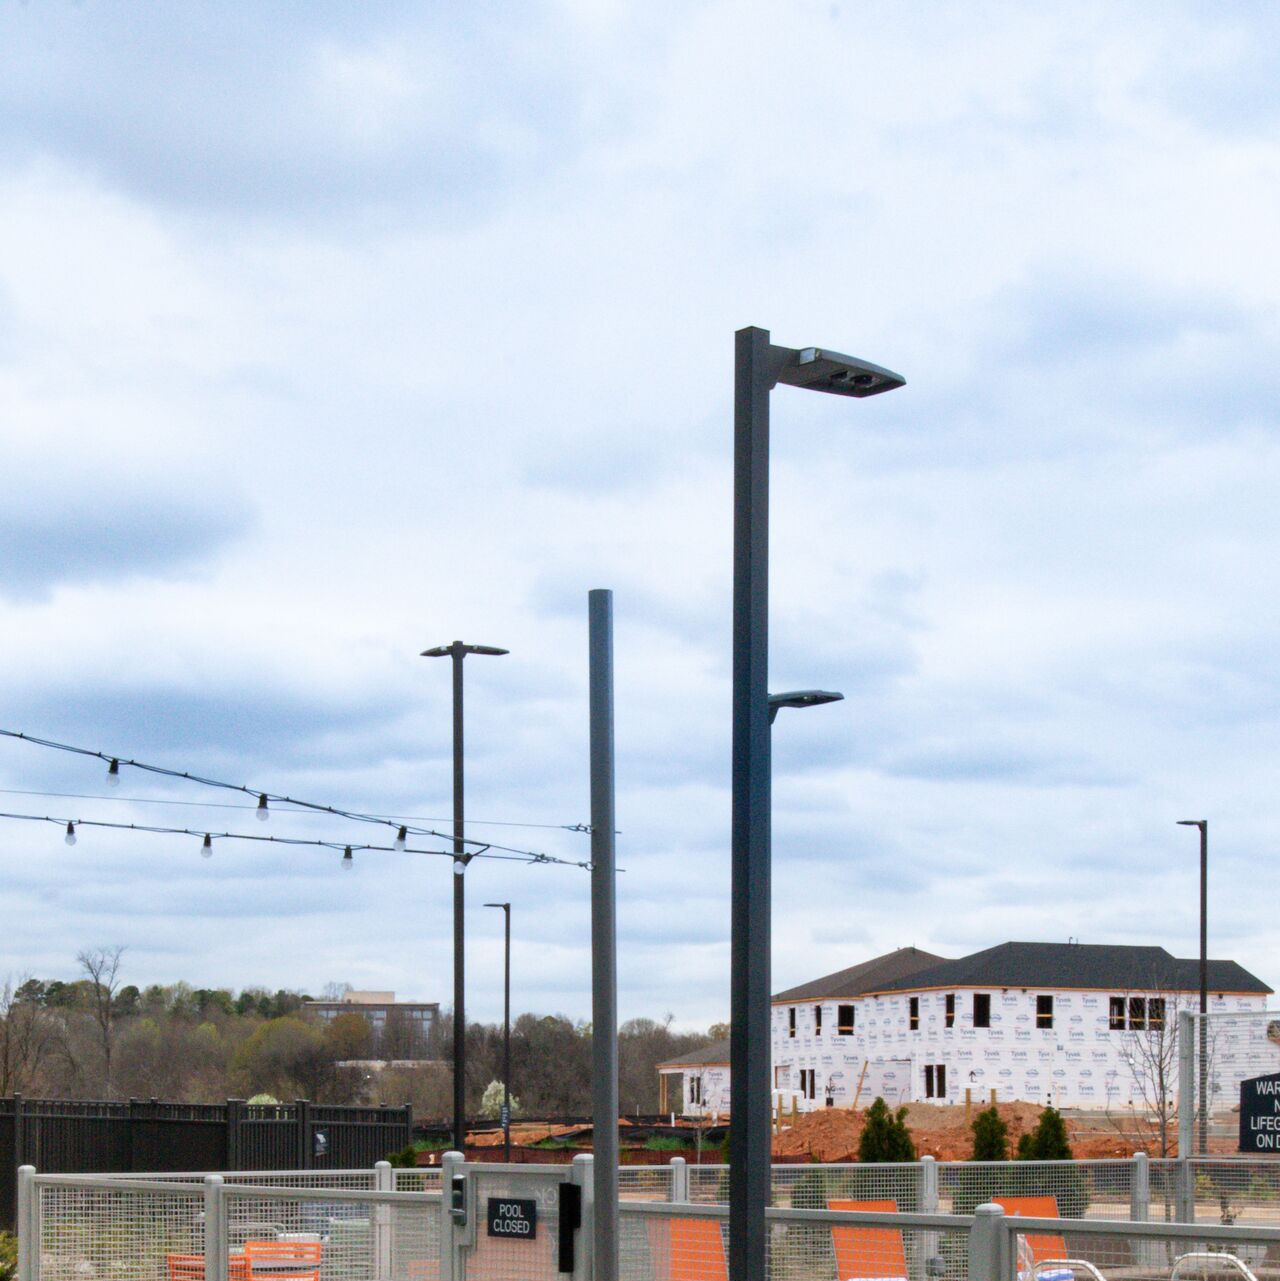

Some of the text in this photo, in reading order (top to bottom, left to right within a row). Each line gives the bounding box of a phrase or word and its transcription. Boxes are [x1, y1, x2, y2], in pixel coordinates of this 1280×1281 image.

[1256, 1134, 1273, 1148] ON
[499, 1204, 524, 1218] POOL
[493, 1219, 530, 1234] CLOSED
